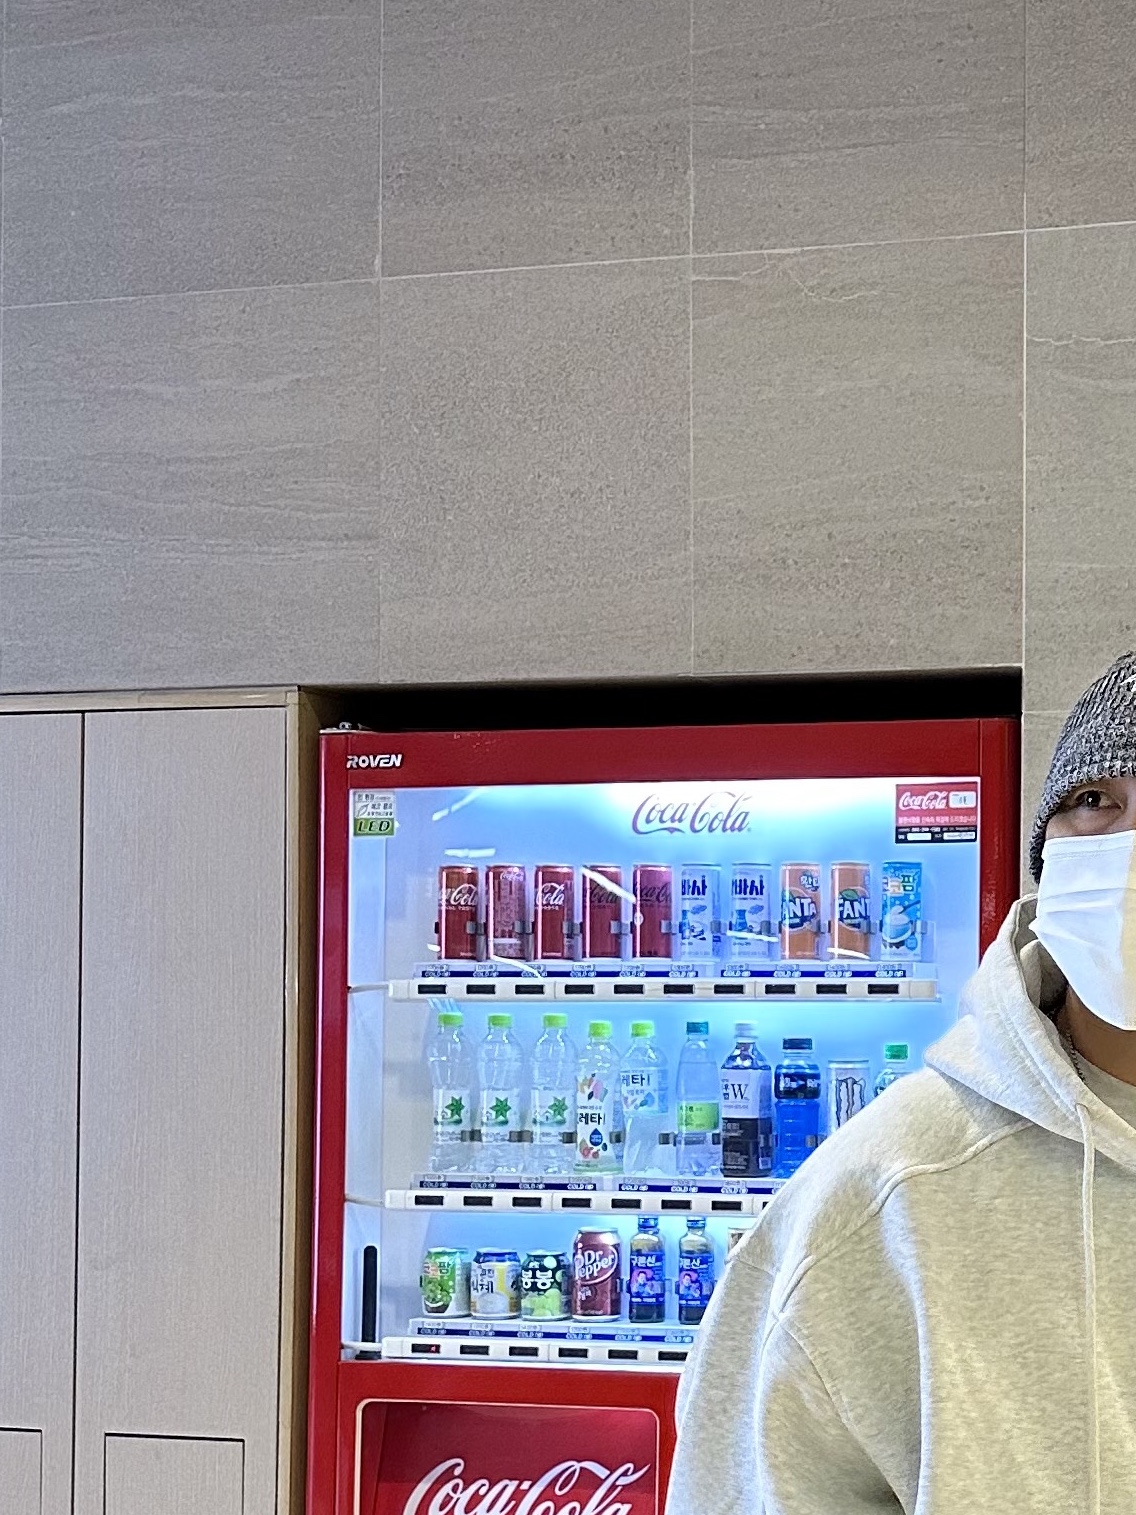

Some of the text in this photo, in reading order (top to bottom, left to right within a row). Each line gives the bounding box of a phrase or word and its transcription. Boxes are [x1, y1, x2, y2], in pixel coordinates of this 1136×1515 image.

[346, 753, 403, 769] ROVEN
[357, 820, 392, 834] LED
[782, 897, 817, 919] ANTA
[574, 1253, 615, 1281] Pepper
[584, 1250, 604, 1266] Dr
[521, 1269, 555, 1290] 봉봉
